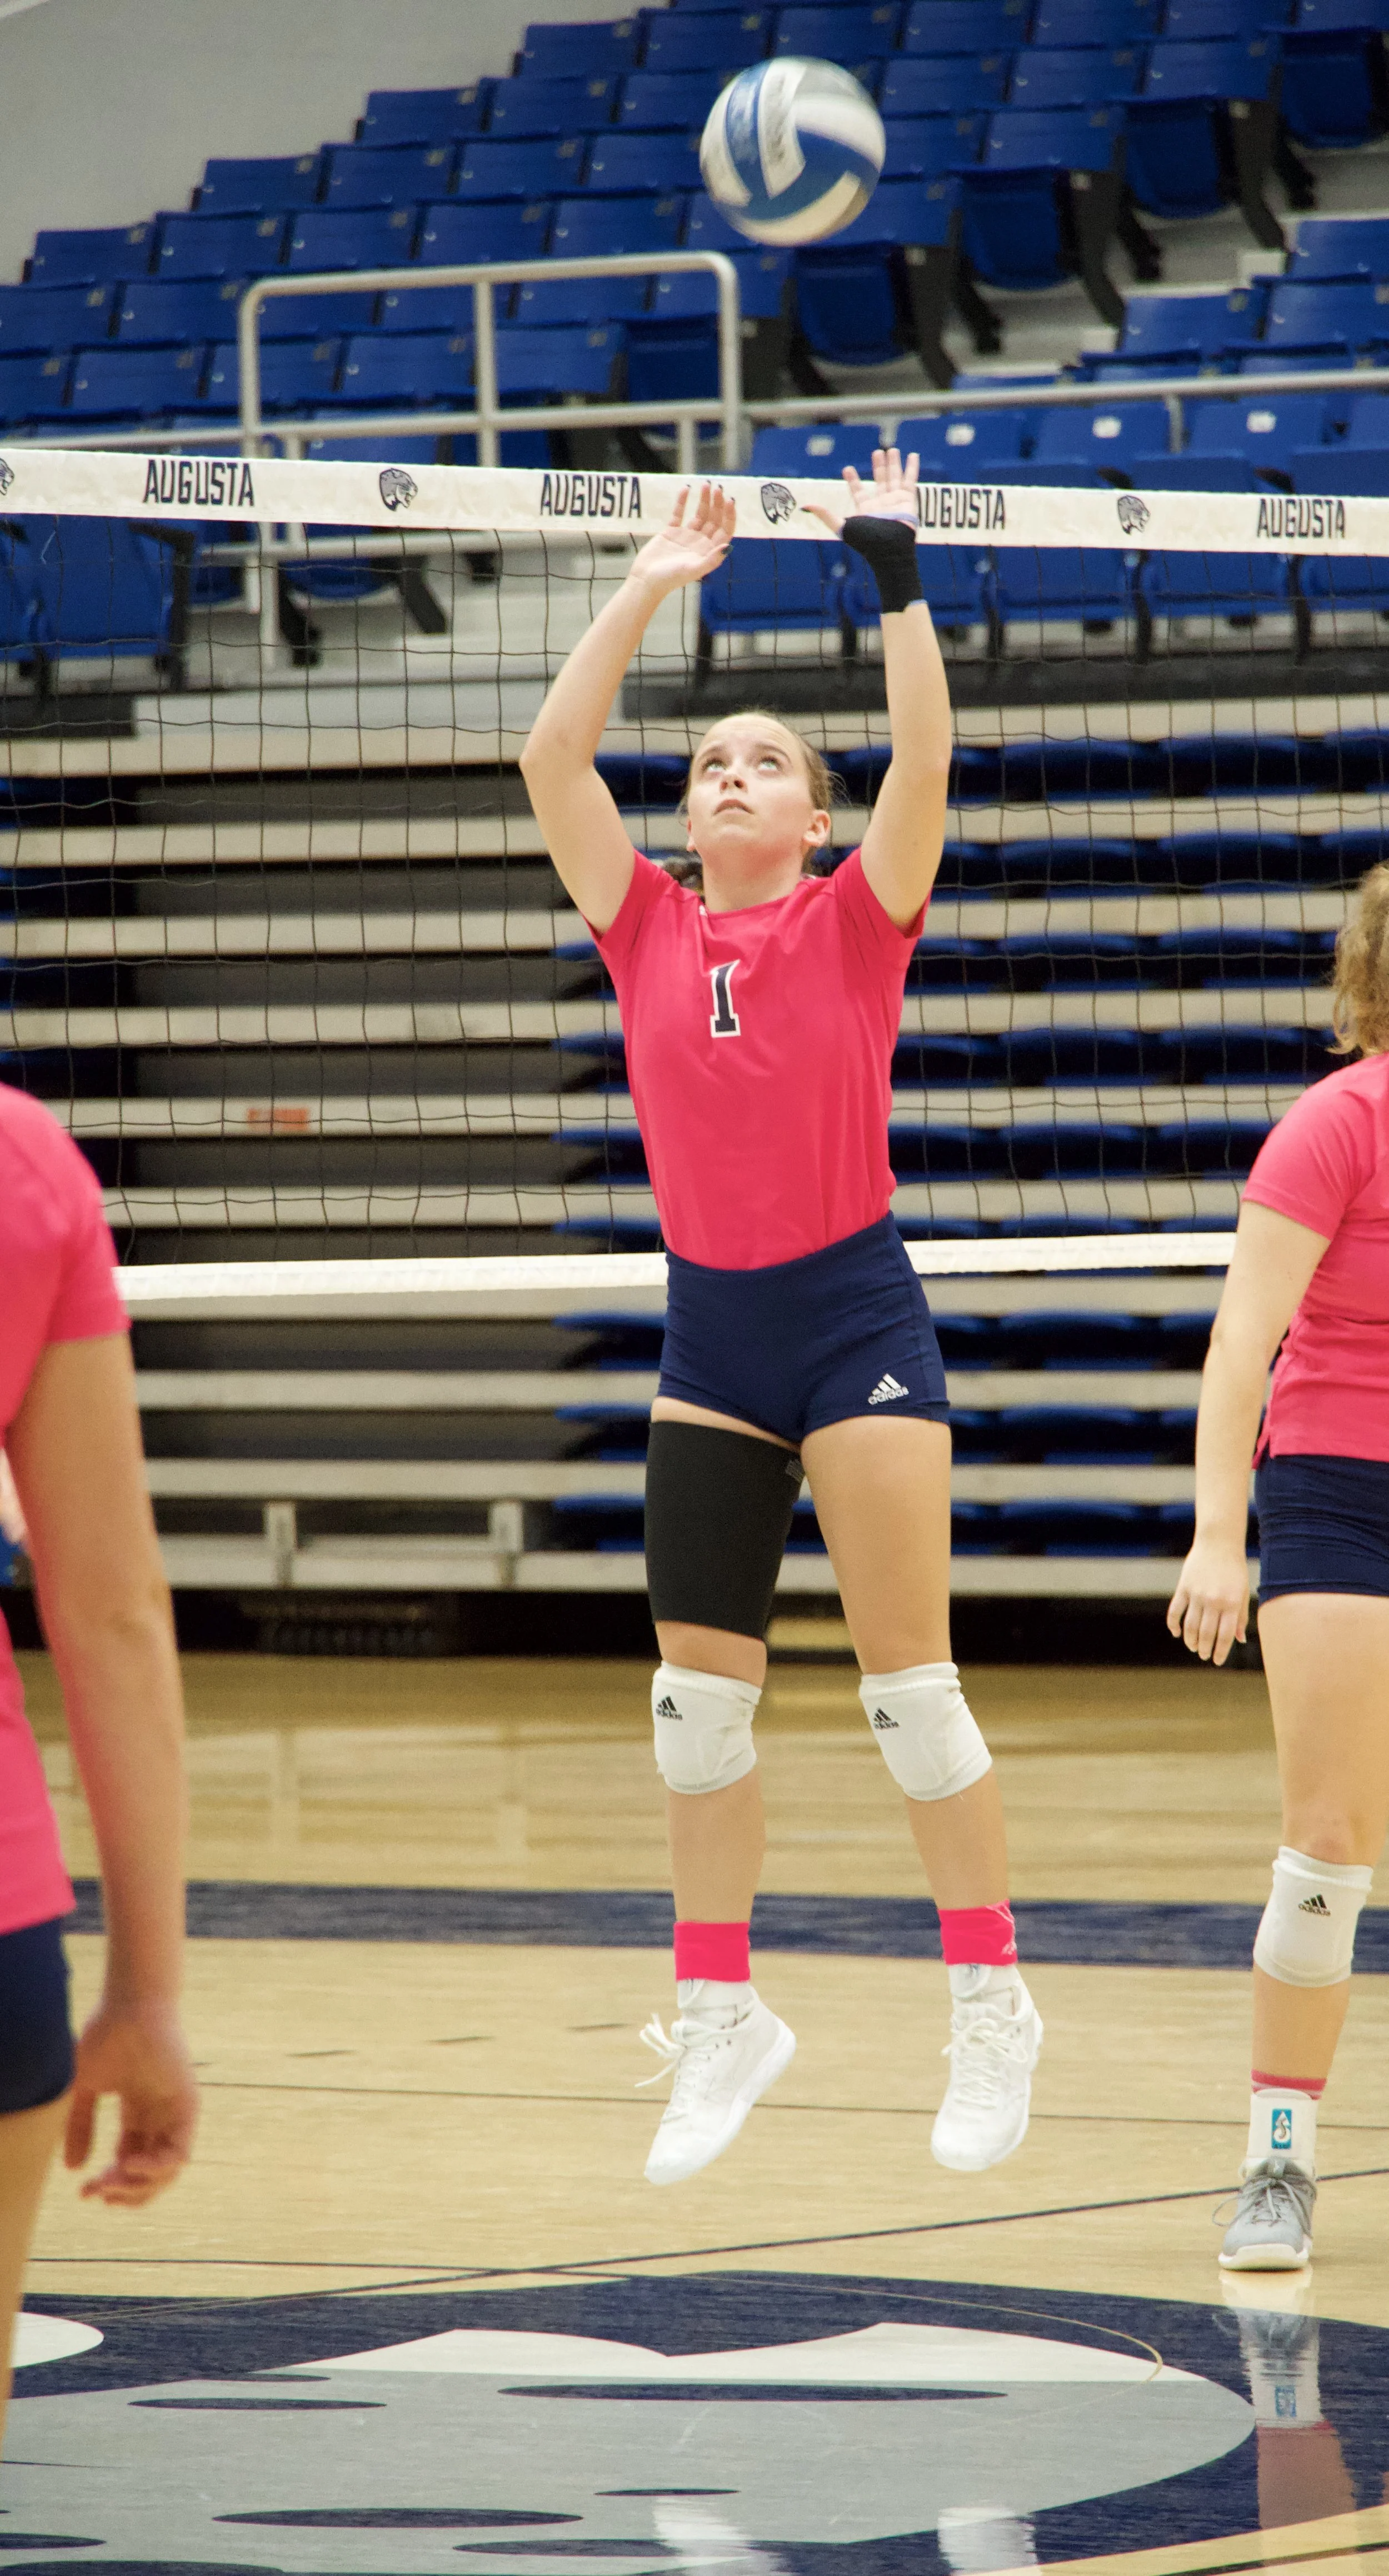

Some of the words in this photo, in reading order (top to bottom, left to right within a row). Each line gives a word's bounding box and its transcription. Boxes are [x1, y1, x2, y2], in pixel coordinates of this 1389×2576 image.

[143, 459, 254, 506] AUGUSTA
[541, 474, 642, 518] AUGUSTA
[1257, 499, 1345, 539] AUGUSTA
[709, 959, 741, 1038] 1
